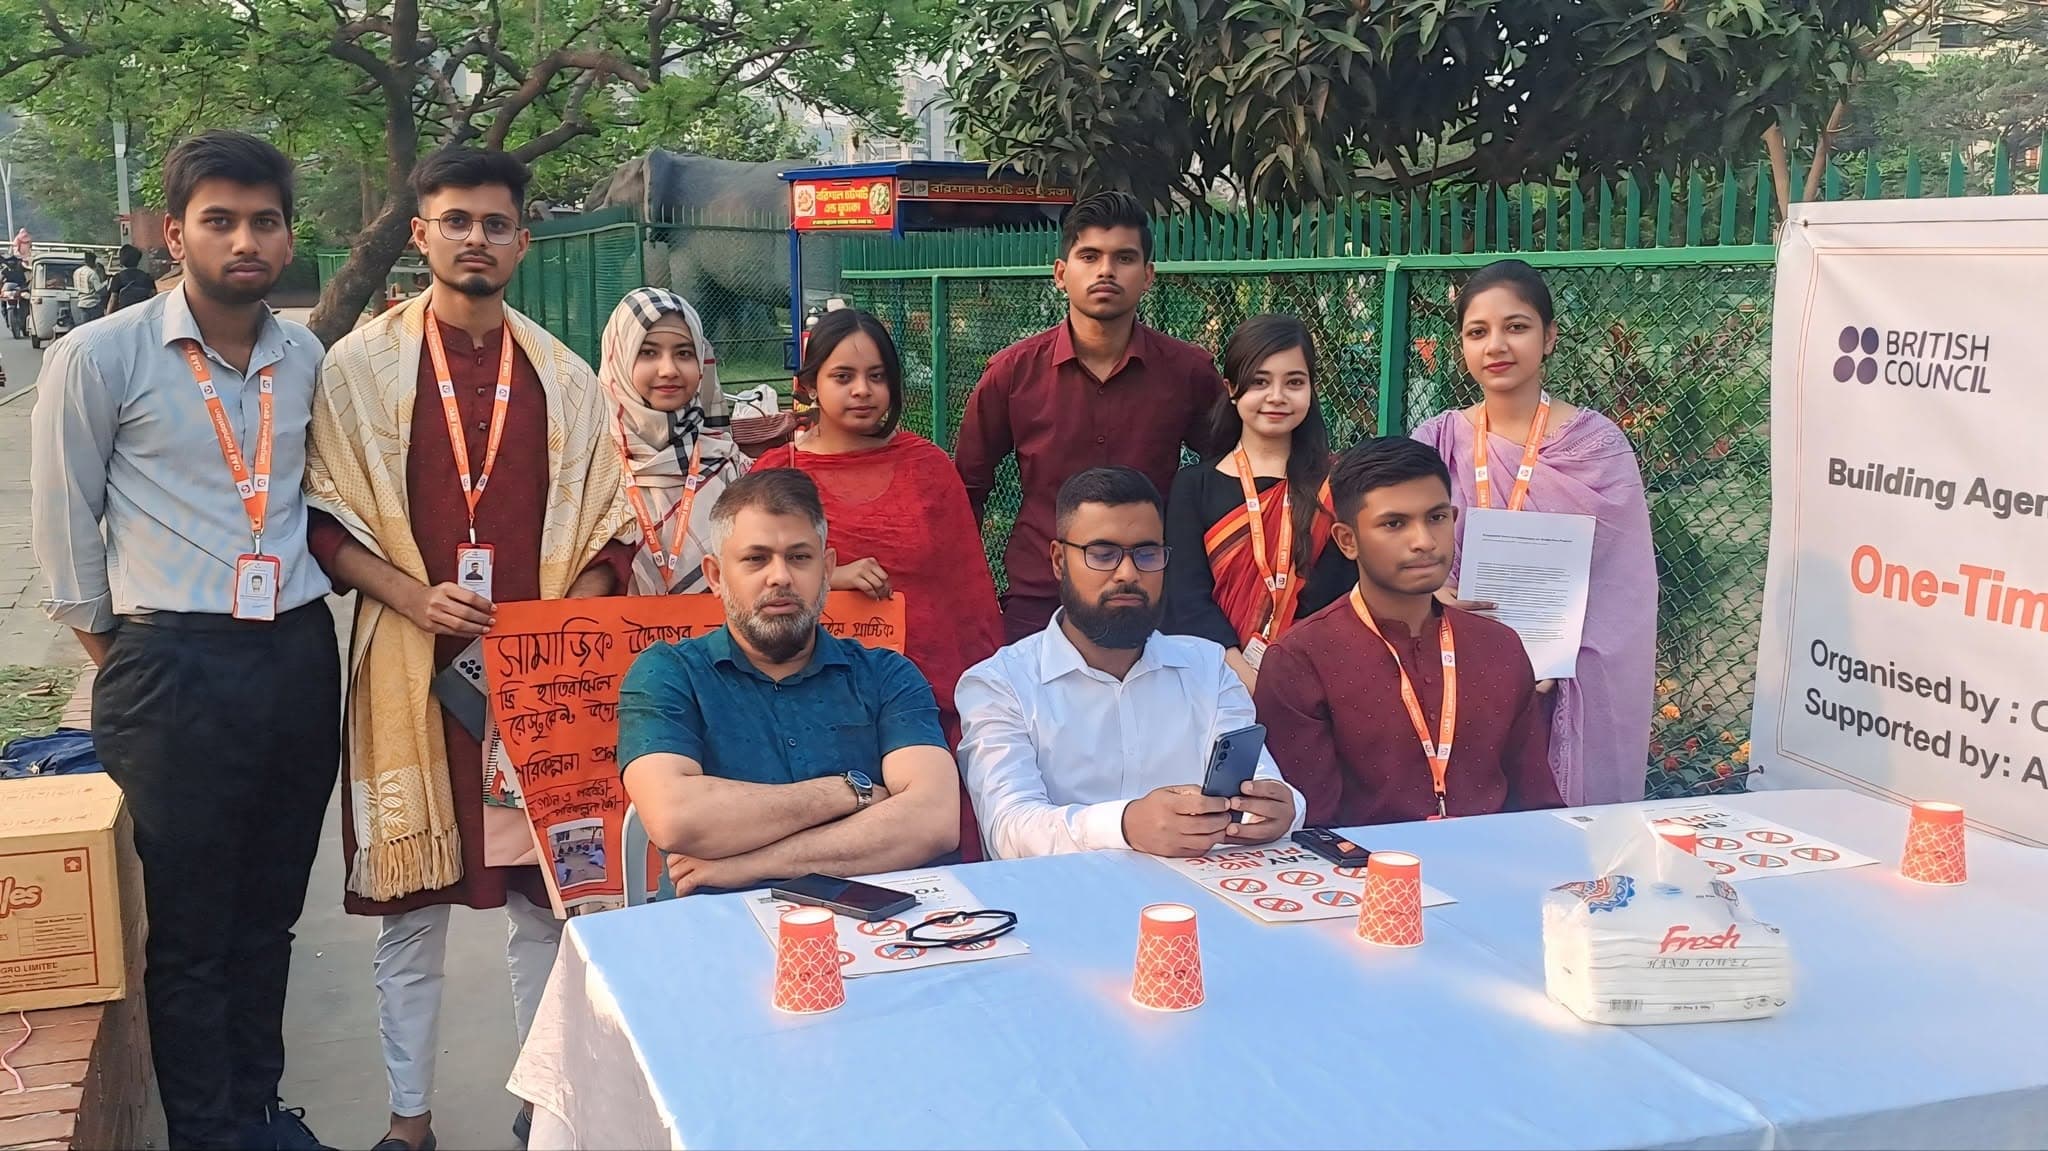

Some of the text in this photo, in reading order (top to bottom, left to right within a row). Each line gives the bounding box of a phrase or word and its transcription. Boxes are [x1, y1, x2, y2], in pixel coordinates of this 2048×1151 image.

[930, 182, 974, 194] বরিশাল
[1886, 330, 1990, 362] BRITISH
[1884, 359, 1992, 394] COUNCIL
[214, 407, 242, 472] OAB Foundation
[259, 420, 270, 464] Foundation
[1828, 457, 1957, 511] Building
[486, 616, 613, 677] সামাজিক
[530, 670, 618, 706] হাতিরঝিল
[1810, 638, 1953, 705] Organised
[1960, 678, 2000, 724] by
[1805, 687, 1951, 760] Supported
[1959, 732, 2010, 781] by:
[1270, 854, 1320, 866] SAY
[1659, 923, 1741, 954] Fresh
[1647, 958, 1689, 969] HAND
